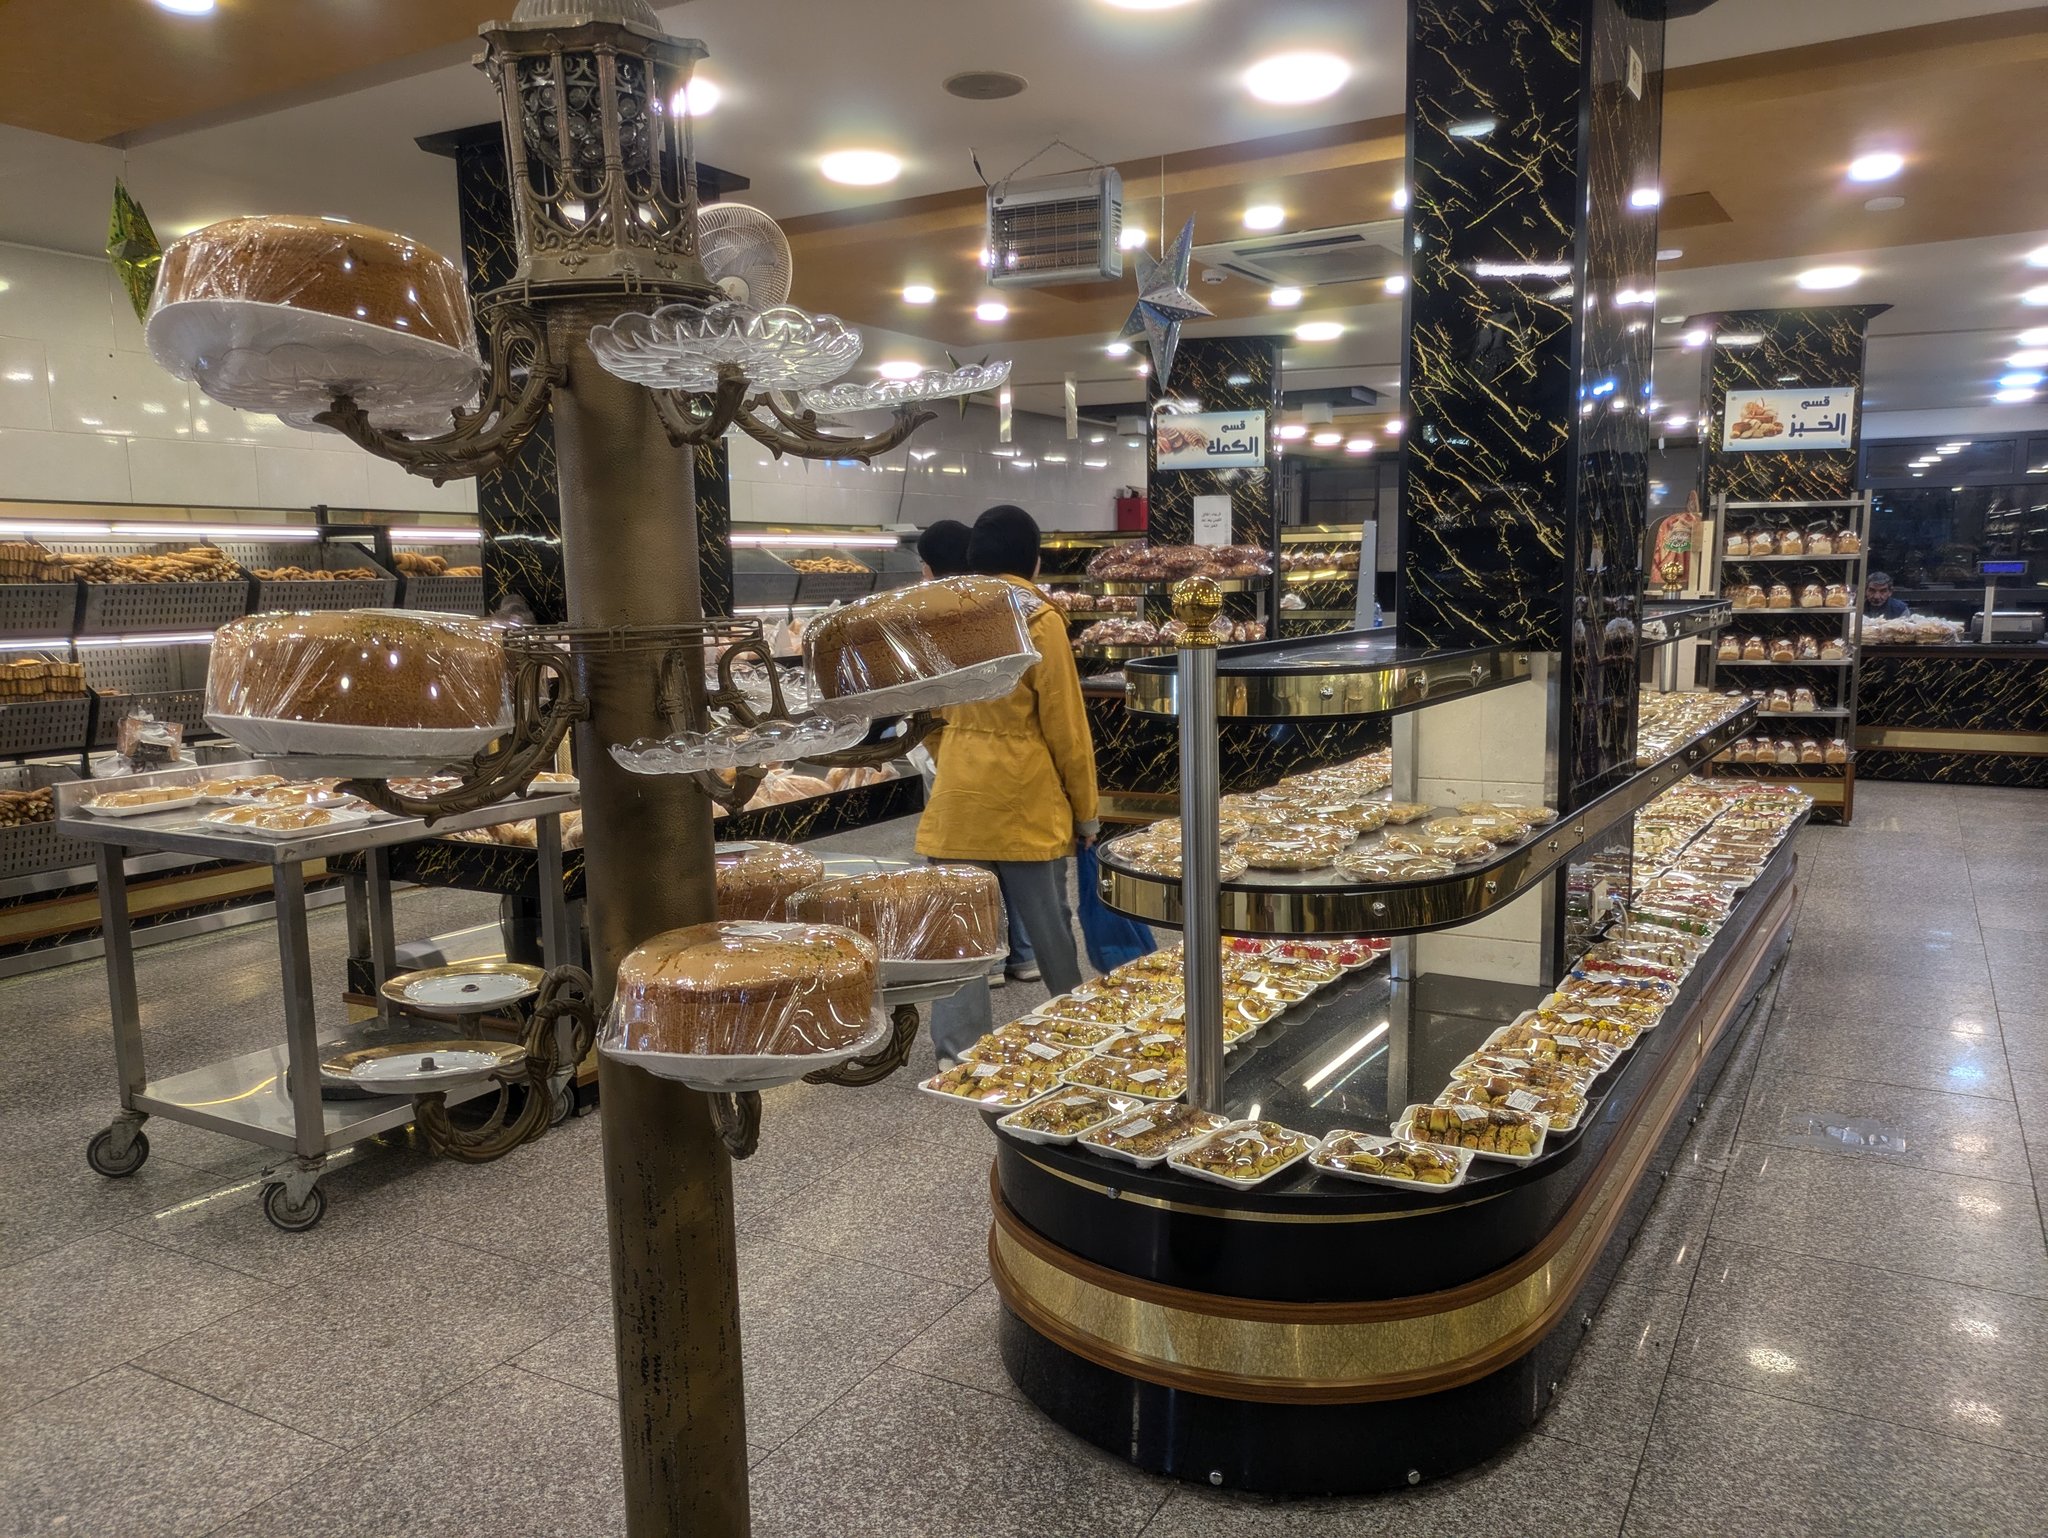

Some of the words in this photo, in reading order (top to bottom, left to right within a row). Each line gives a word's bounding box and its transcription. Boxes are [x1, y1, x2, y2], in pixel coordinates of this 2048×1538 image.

[1801, 395, 1830, 410] قسم
[1221, 420, 1246, 433] قسم
[1788, 412, 1847, 438] الخبز
[1206, 436, 1259, 458] الكعك
